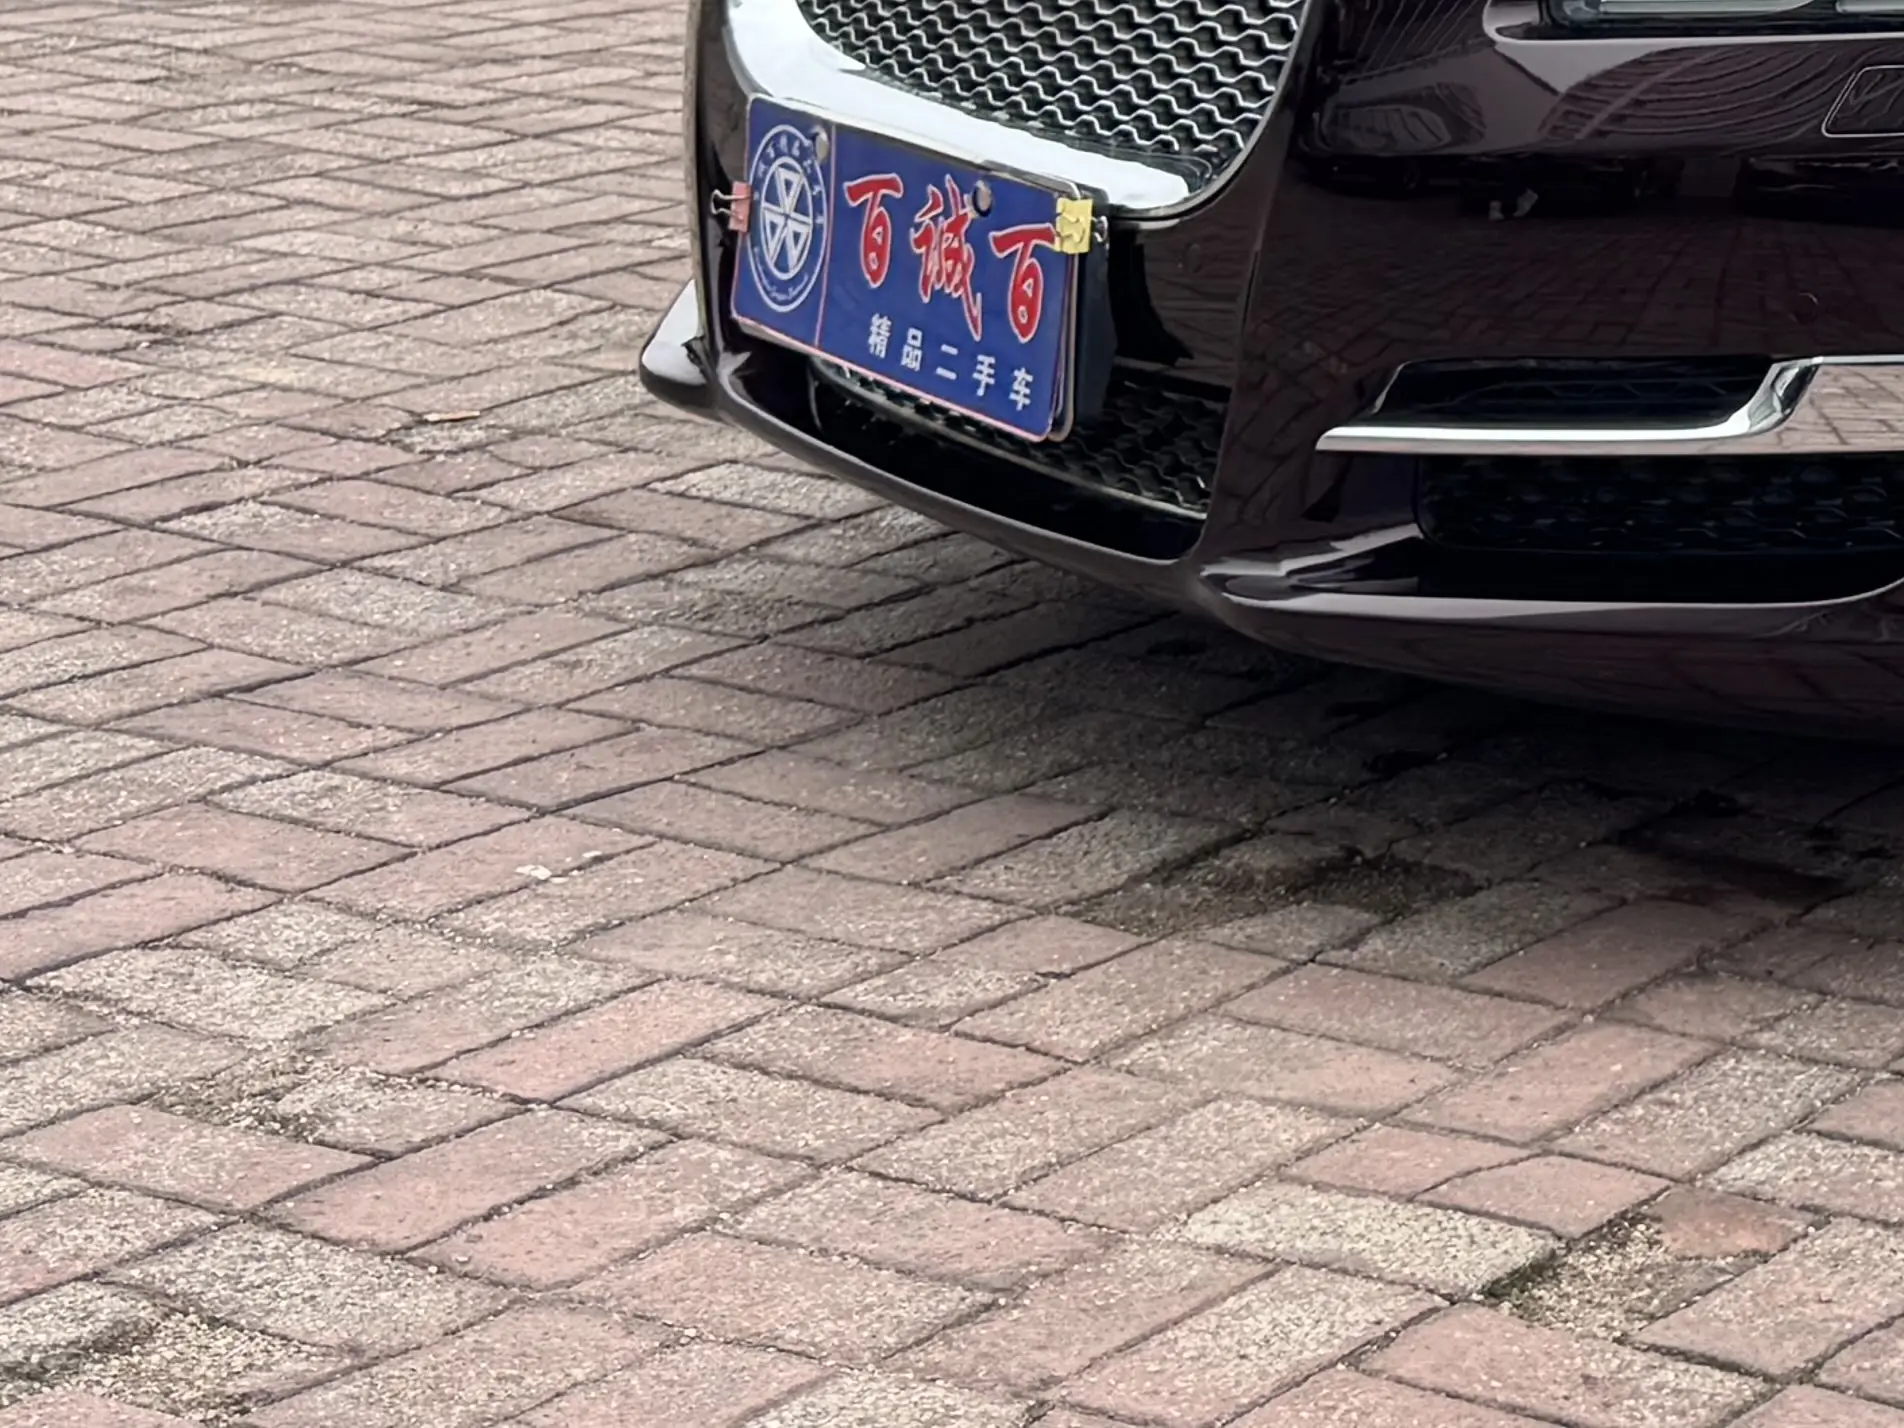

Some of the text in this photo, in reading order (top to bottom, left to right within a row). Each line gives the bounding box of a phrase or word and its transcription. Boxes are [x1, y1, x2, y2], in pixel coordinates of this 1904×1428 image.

[867, 313, 1034, 412] 精品二手车
